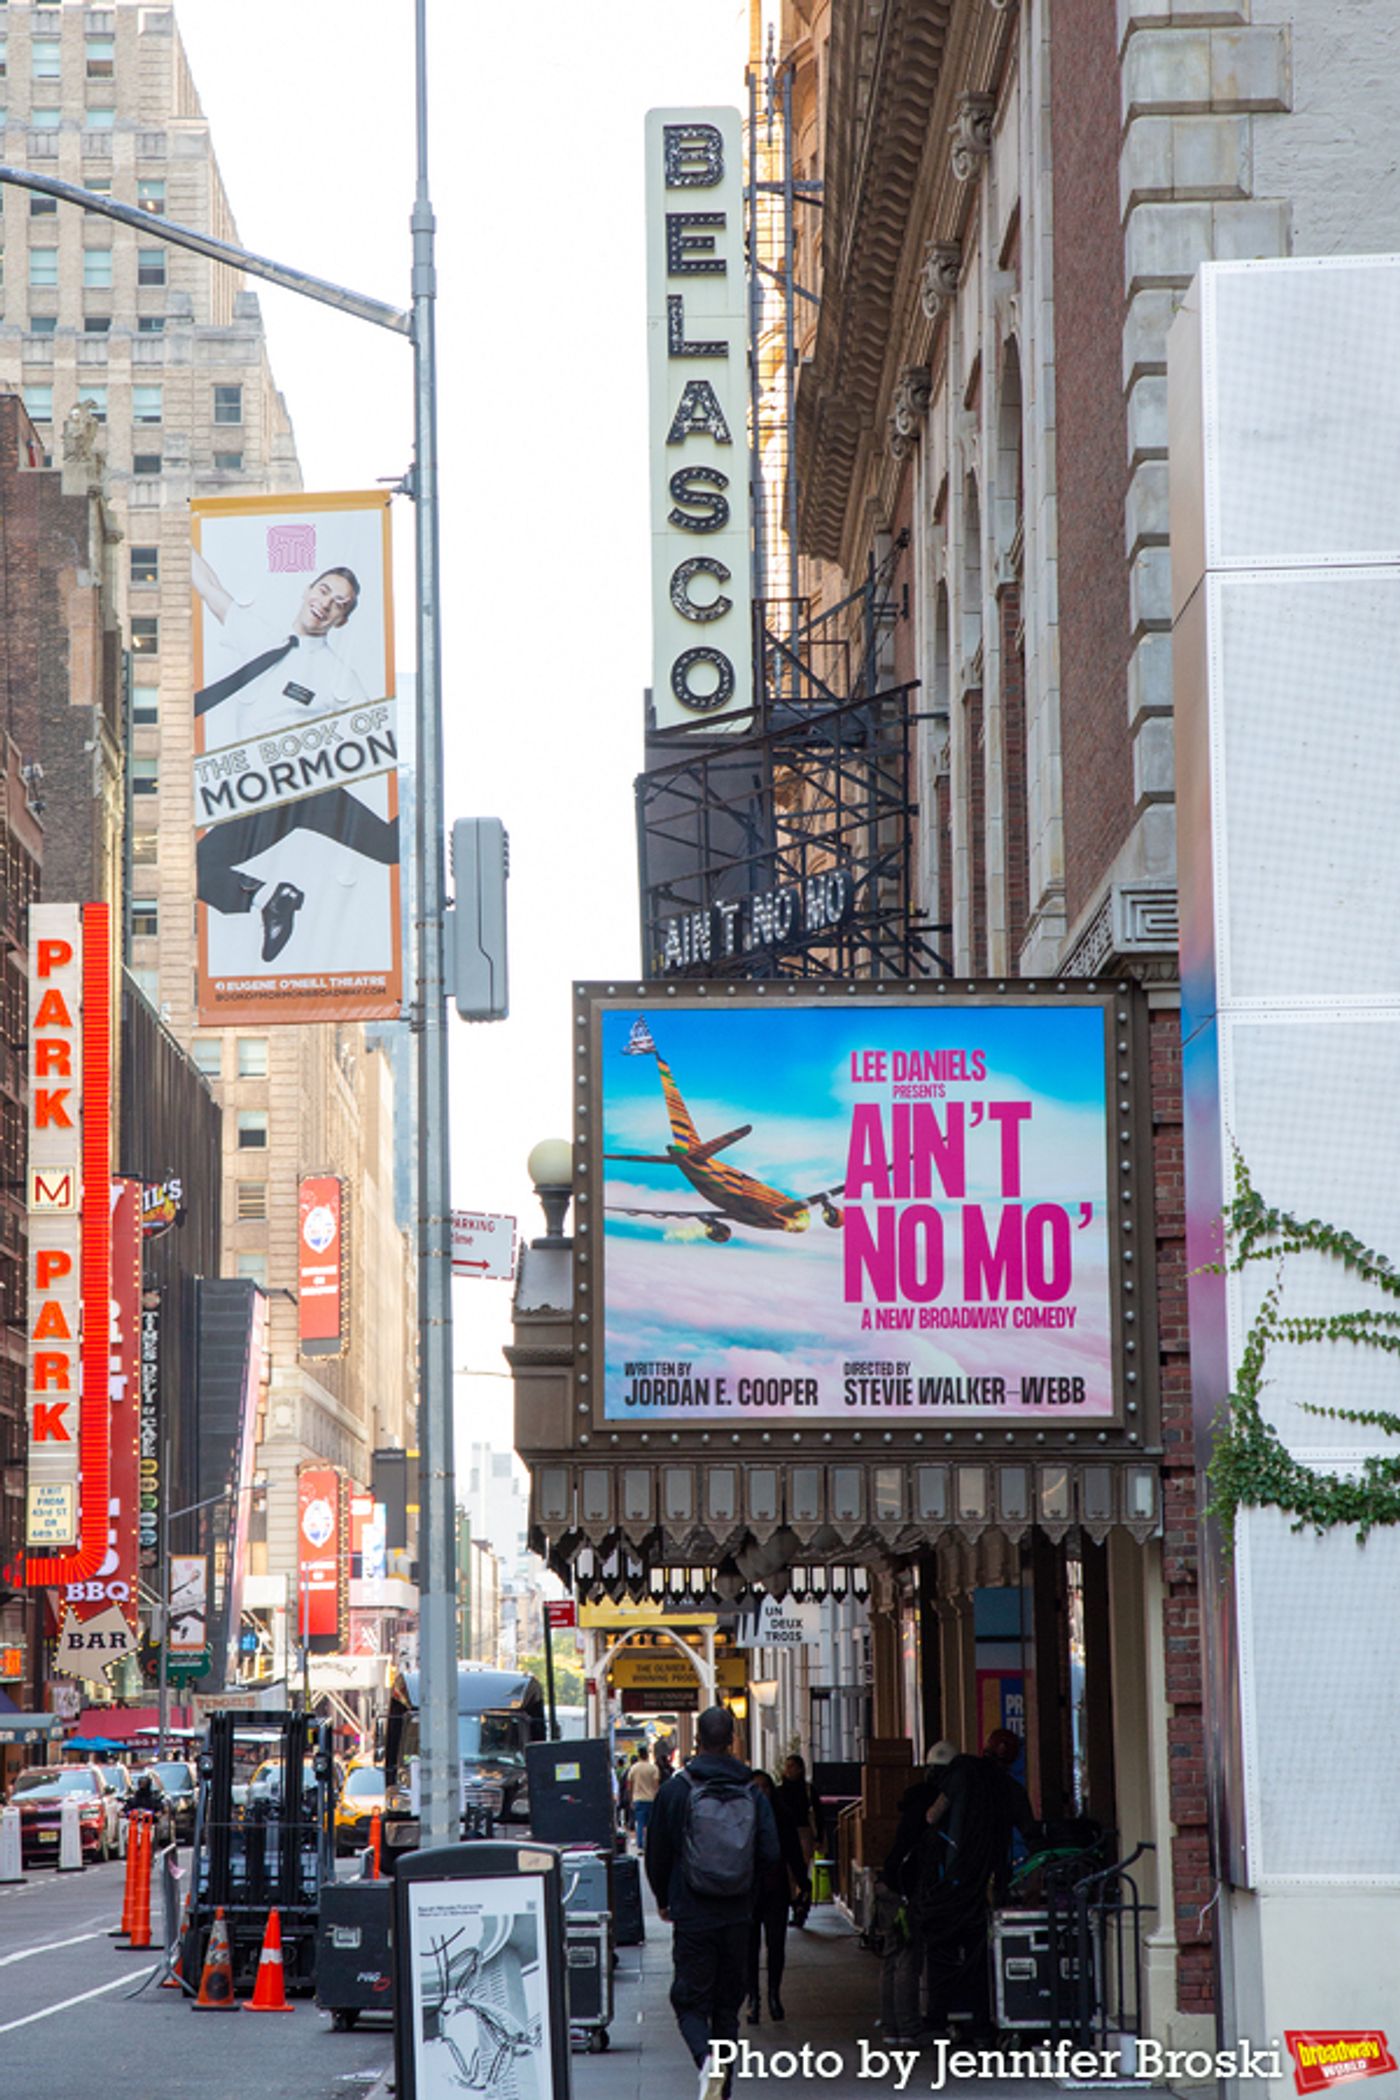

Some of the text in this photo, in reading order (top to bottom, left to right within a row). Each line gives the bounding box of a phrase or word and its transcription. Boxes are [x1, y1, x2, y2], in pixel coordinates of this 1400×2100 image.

[662, 122, 736, 713] BELASCO
[195, 706, 389, 782] THE BOOK OF
[200, 730, 398, 806] MORMON
[753, 888, 791, 945] NO
[227, 980, 276, 991] EUGENE
[329, 975, 387, 987] THEATRE
[33, 938, 73, 1129] PARK
[852, 1049, 987, 1083] LEE DANIELS
[892, 1083, 947, 1099] PRESENTS
[844, 1101, 1033, 1200] AIN'T
[844, 1202, 1094, 1304] NO MO'
[861, 1306, 1078, 1331] A NEW BROADWAY COMEDY
[32, 1250, 73, 1442] PARK
[624, 1362, 693, 1377] WRITTEN BY
[843, 1361, 912, 1377] DIRECTED BY
[624, 1377, 818, 1407] JORDAN E. COOPER
[843, 1378, 913, 1406] STEVIE
[56, 1508, 67, 1516] ST
[56, 1529, 67, 1537] ST
[65, 1580, 130, 1602] BBQ
[765, 1606, 784, 1616] UN
[770, 1618, 804, 1628] DEUX
[67, 1632, 128, 1650] BAR
[764, 1631, 802, 1642] TROIS
